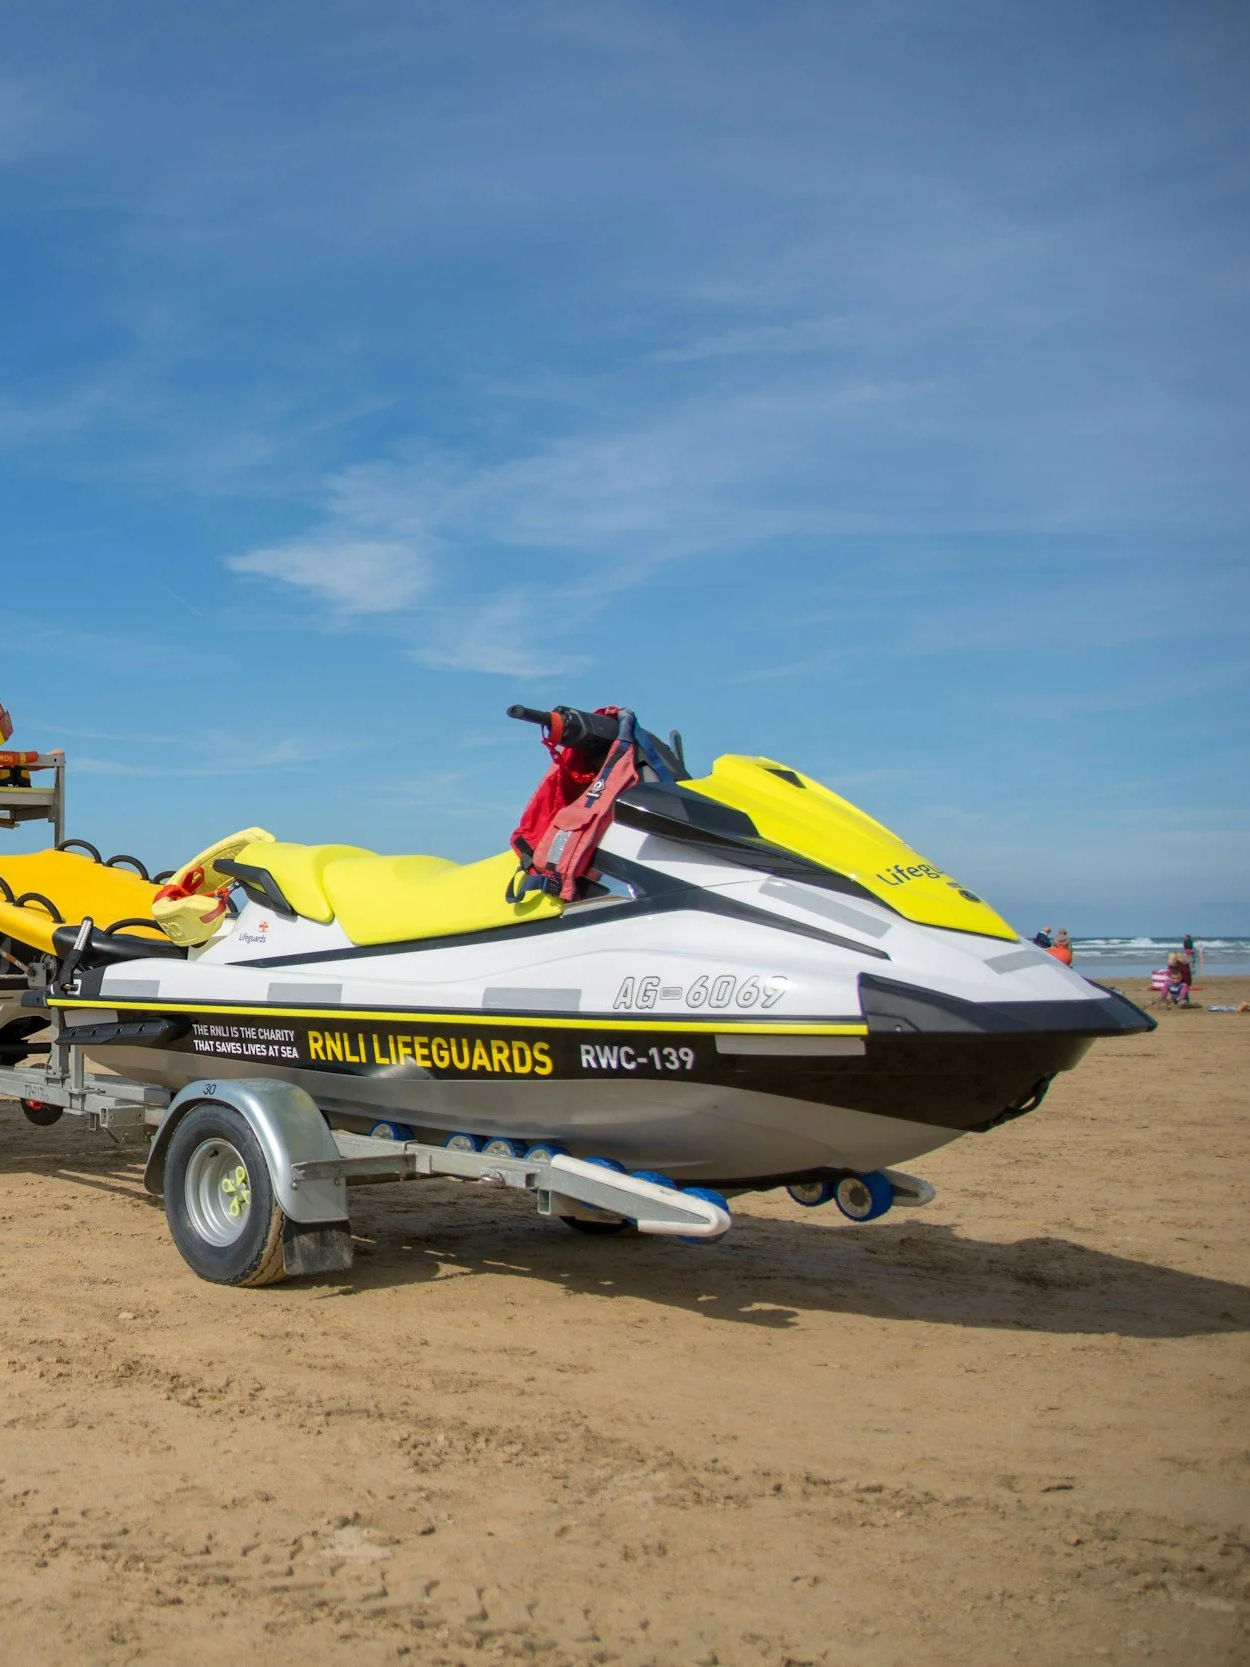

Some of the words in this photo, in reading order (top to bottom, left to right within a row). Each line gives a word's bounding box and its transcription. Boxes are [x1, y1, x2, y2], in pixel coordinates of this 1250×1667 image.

[876, 864, 944, 886] Lifeg
[239, 933, 267, 944] Lifeguards
[192, 1024, 209, 1036] THE
[210, 1025, 229, 1037] RNLI
[230, 1026, 238, 1038] IS
[240, 1027, 257, 1039] THE
[258, 1028, 295, 1042] CHARITY
[194, 1040, 214, 1052] THAT
[215, 1041, 242, 1054] SAVES
[243, 1043, 267, 1056] LIVES
[268, 1045, 280, 1057] AT
[281, 1046, 299, 1059] SEA
[308, 1030, 367, 1063] RNLI
[372, 1033, 553, 1075] LIFEGUARDS
[580, 1044, 695, 1070] RWC-139
[203, 1083, 217, 1095] 30
